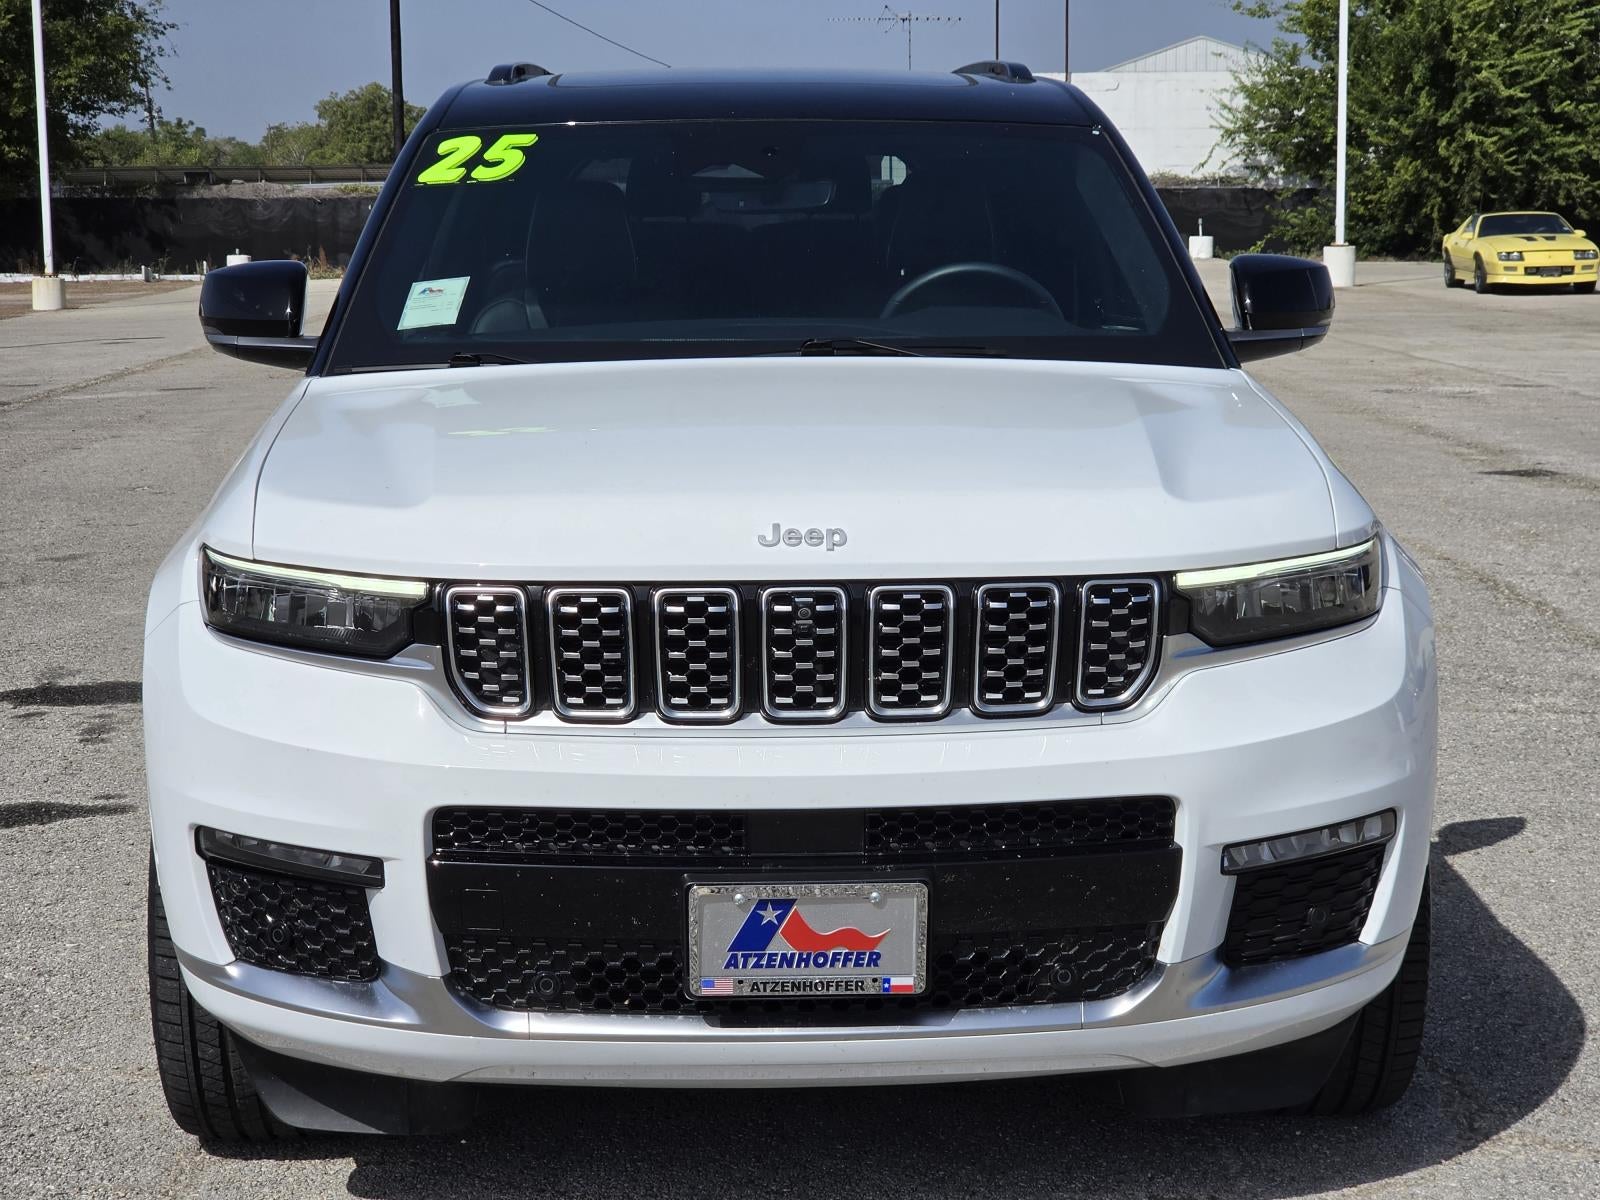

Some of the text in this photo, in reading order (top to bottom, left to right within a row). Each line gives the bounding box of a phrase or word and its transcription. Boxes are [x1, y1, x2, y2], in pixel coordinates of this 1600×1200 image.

[417, 133, 539, 184] 25
[757, 522, 848, 551] Jeep
[723, 951, 882, 970] ATZENHOFFER
[750, 978, 865, 993] ATZENHOFFER
